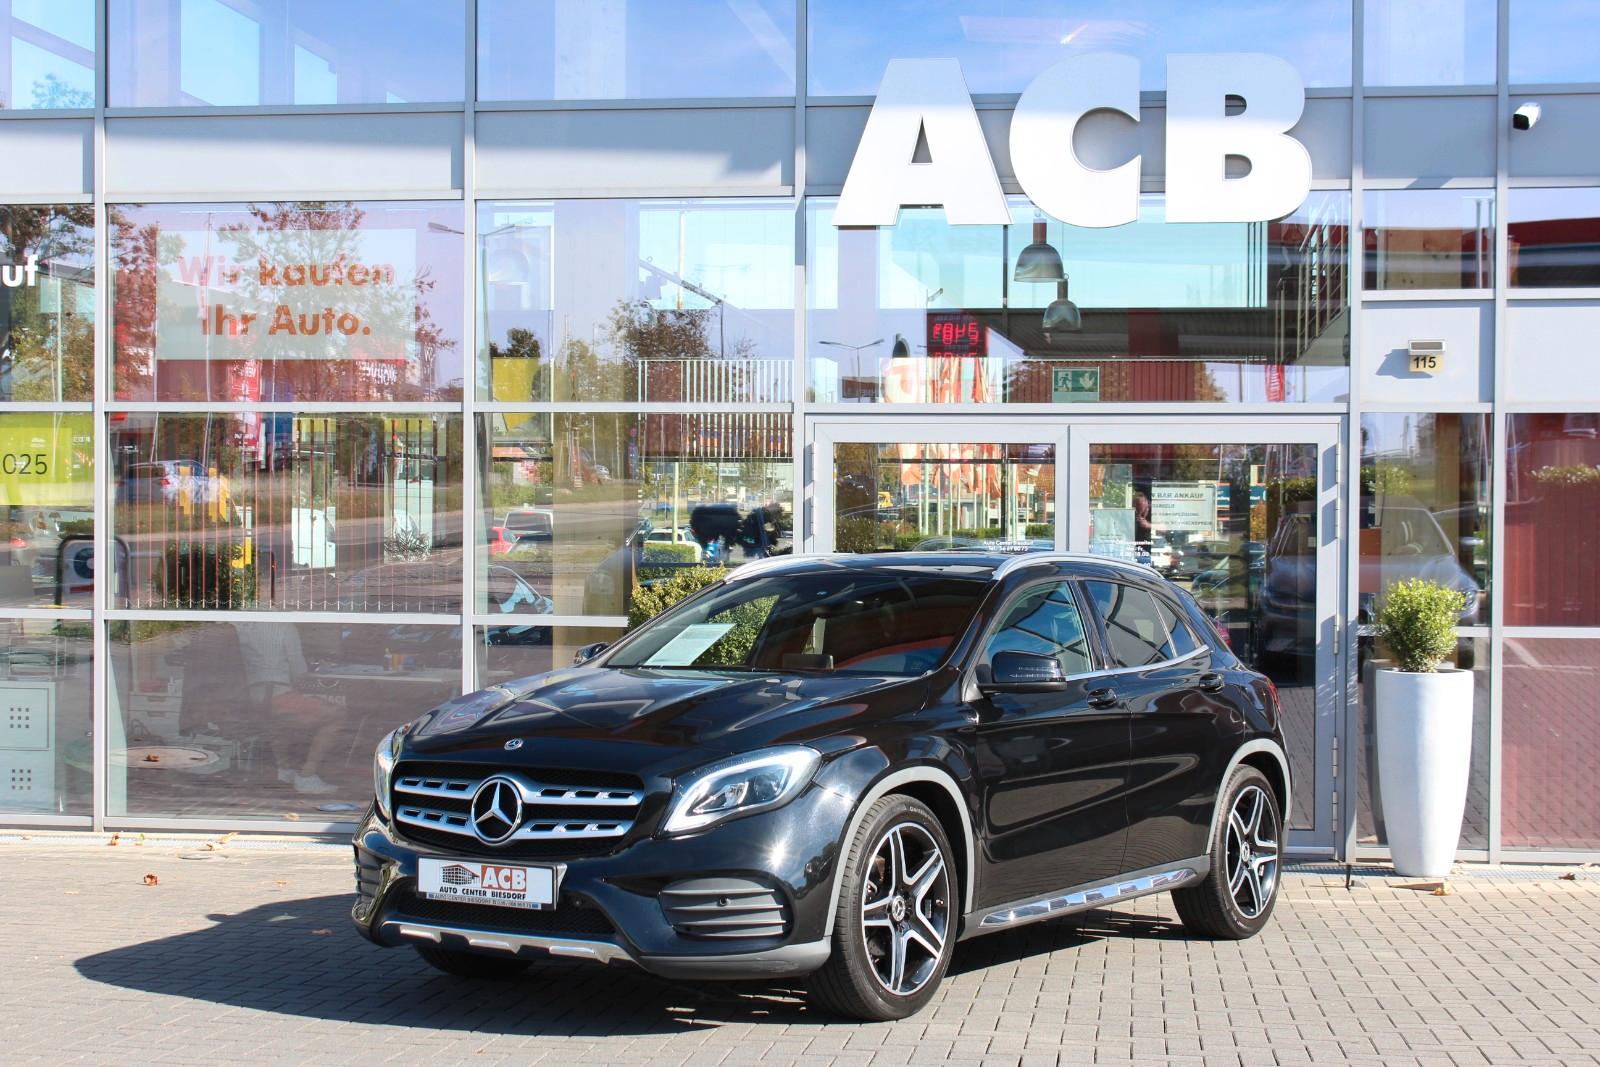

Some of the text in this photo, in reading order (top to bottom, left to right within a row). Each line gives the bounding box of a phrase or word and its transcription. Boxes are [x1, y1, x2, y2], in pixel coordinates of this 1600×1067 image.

[831, 51, 1312, 228] ACB
[176, 252, 395, 286] Wir kaufen
[202, 304, 371, 336] Ihr Auto.
[1413, 356, 1437, 368] 115
[481, 866, 526, 891] ACB
[440, 886, 527, 901] AUTO CENTER BIESDORF
